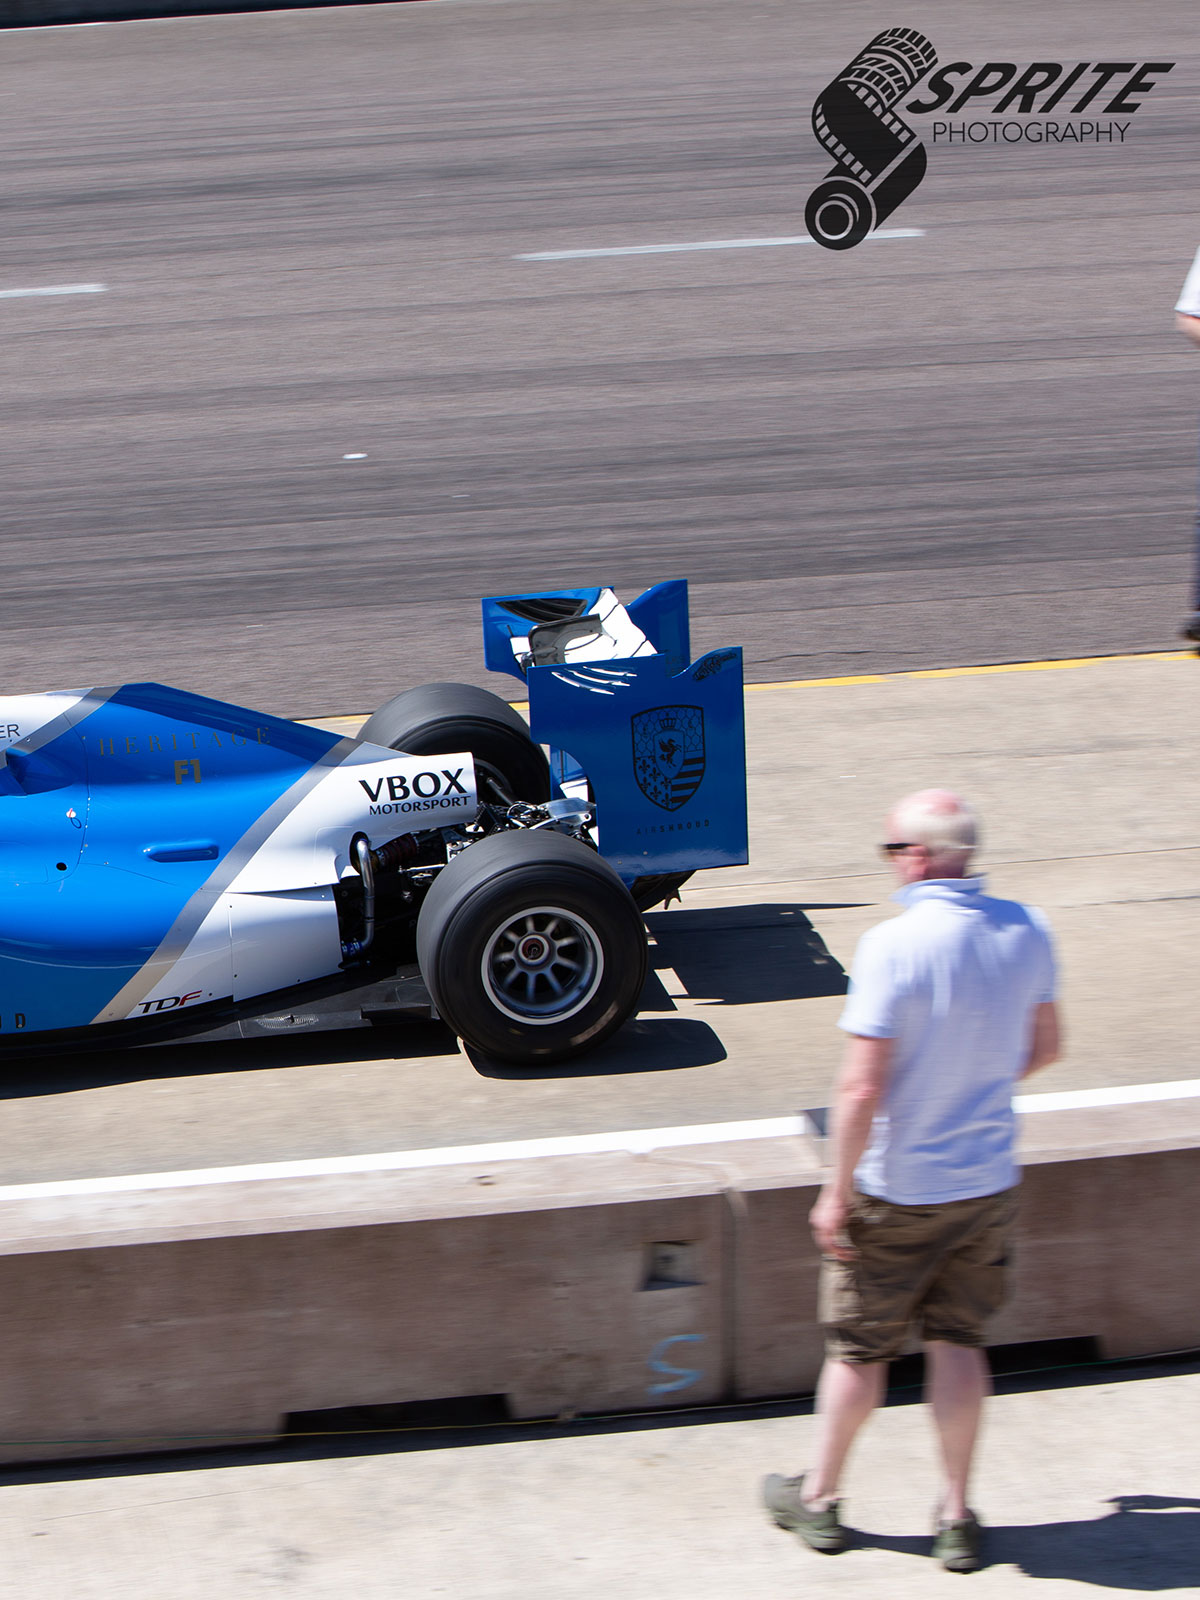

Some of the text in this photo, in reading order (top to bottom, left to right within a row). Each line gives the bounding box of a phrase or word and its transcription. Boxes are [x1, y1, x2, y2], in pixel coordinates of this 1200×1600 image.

[99, 727, 270, 756] HERITAGE
[174, 759, 201, 785] F1
[358, 768, 467, 802] VBOX
[369, 795, 471, 816] MOTORSPORT
[636, 819, 709, 835] AIRSHROUD
[138, 989, 202, 1014] TDF
